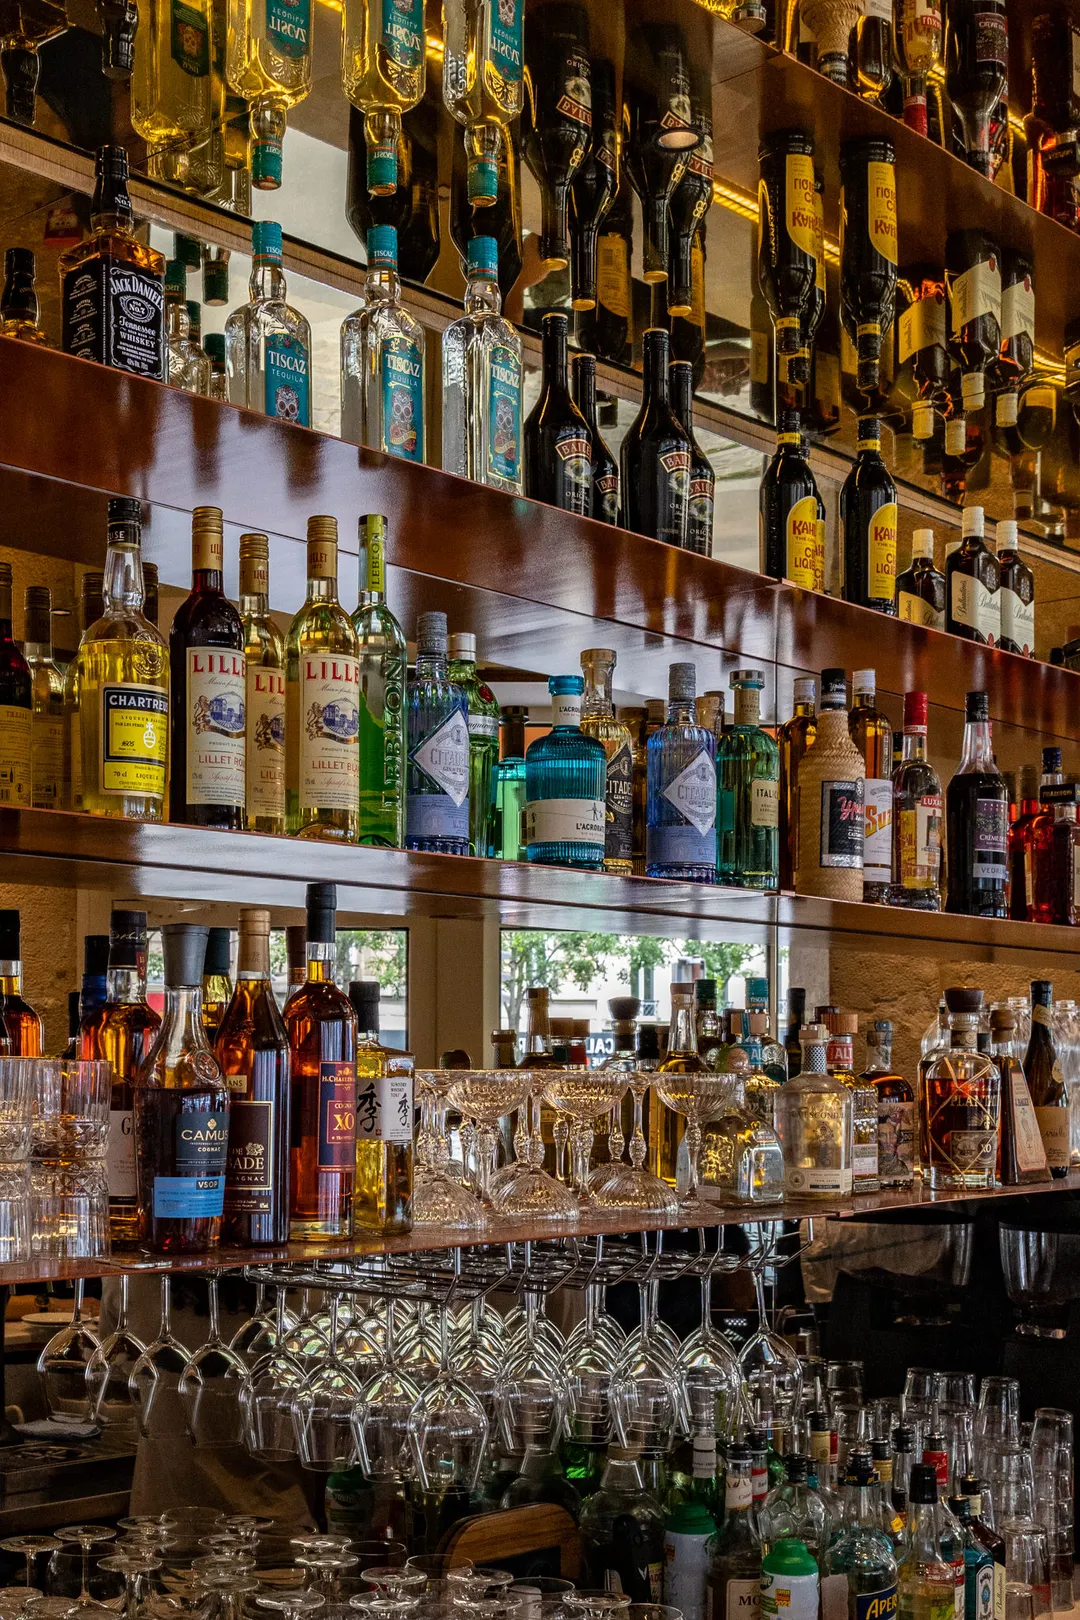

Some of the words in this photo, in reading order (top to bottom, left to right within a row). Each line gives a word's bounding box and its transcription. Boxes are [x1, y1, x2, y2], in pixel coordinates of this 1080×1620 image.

[109, 277, 132, 295] JACK
[119, 331, 156, 348] WHISKEY
[268, 350, 307, 375] TISCAZ
[385, 354, 421, 378] TISCAZ
[272, 369, 304, 384] TEQUILA
[388, 372, 419, 388] TEQUILA
[490, 363, 520, 389] TISCAZ
[493, 381, 518, 397] TEQUILA
[199, 754, 231, 765] LILLET
[312, 760, 346, 770] LILLET
[356, 1082, 382, 1133] 季
[397, 1092, 410, 1126] 季
[333, 1111, 355, 1131] XO
[181, 1129, 229, 1141] CAMUS
[197, 1181, 218, 1189] VSOP
